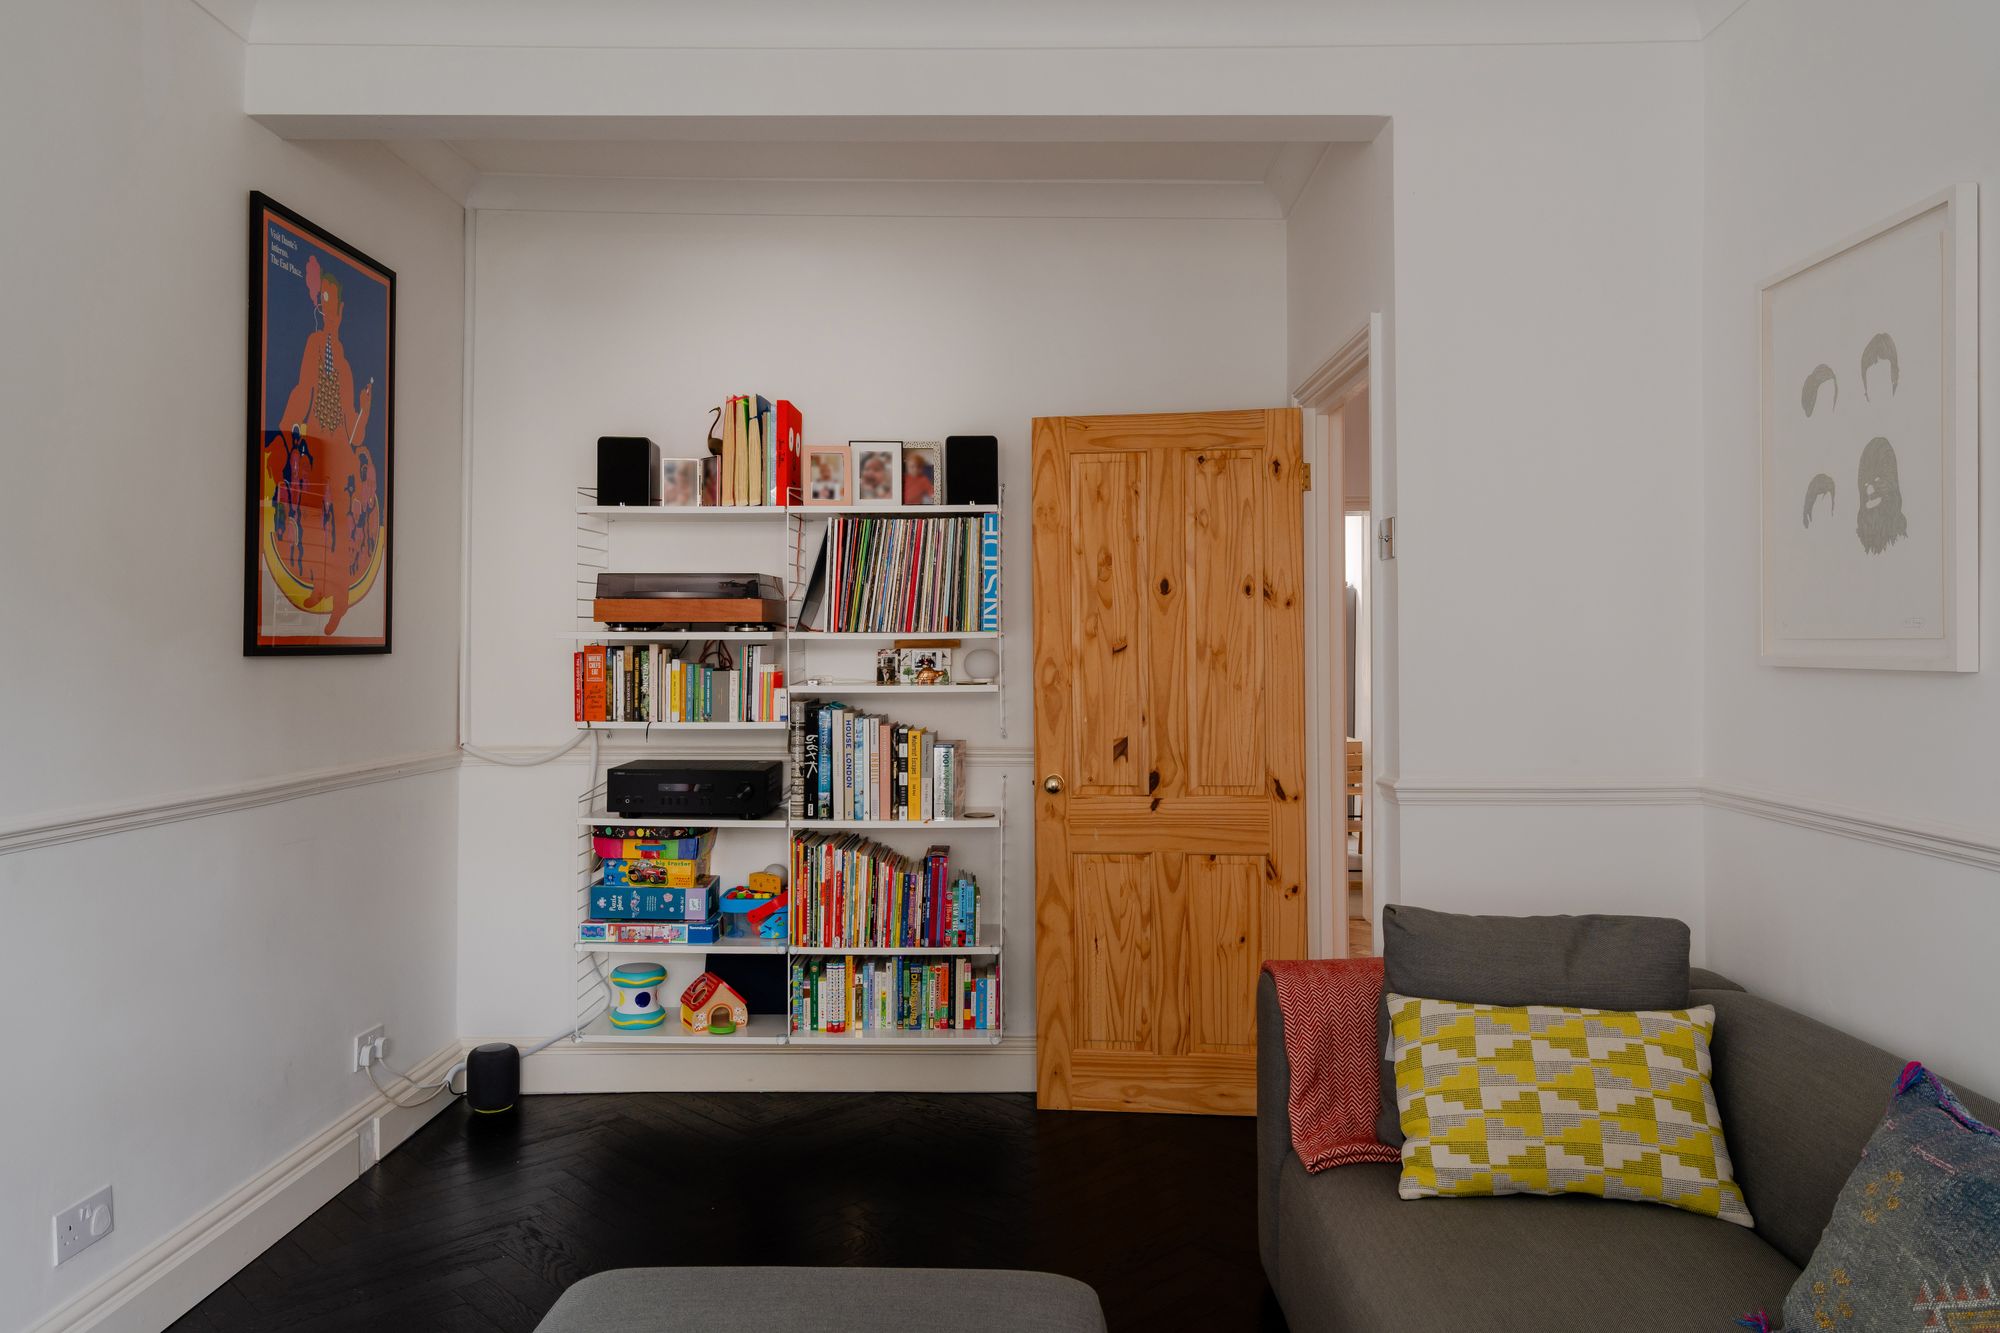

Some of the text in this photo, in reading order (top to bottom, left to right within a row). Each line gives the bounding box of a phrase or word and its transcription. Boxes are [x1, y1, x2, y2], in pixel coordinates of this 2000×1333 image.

[270, 253, 280, 266] The
[280, 258, 289, 271] End
[984, 517, 998, 628] INSIDE
[909, 973, 918, 1026] DINOSAURS
